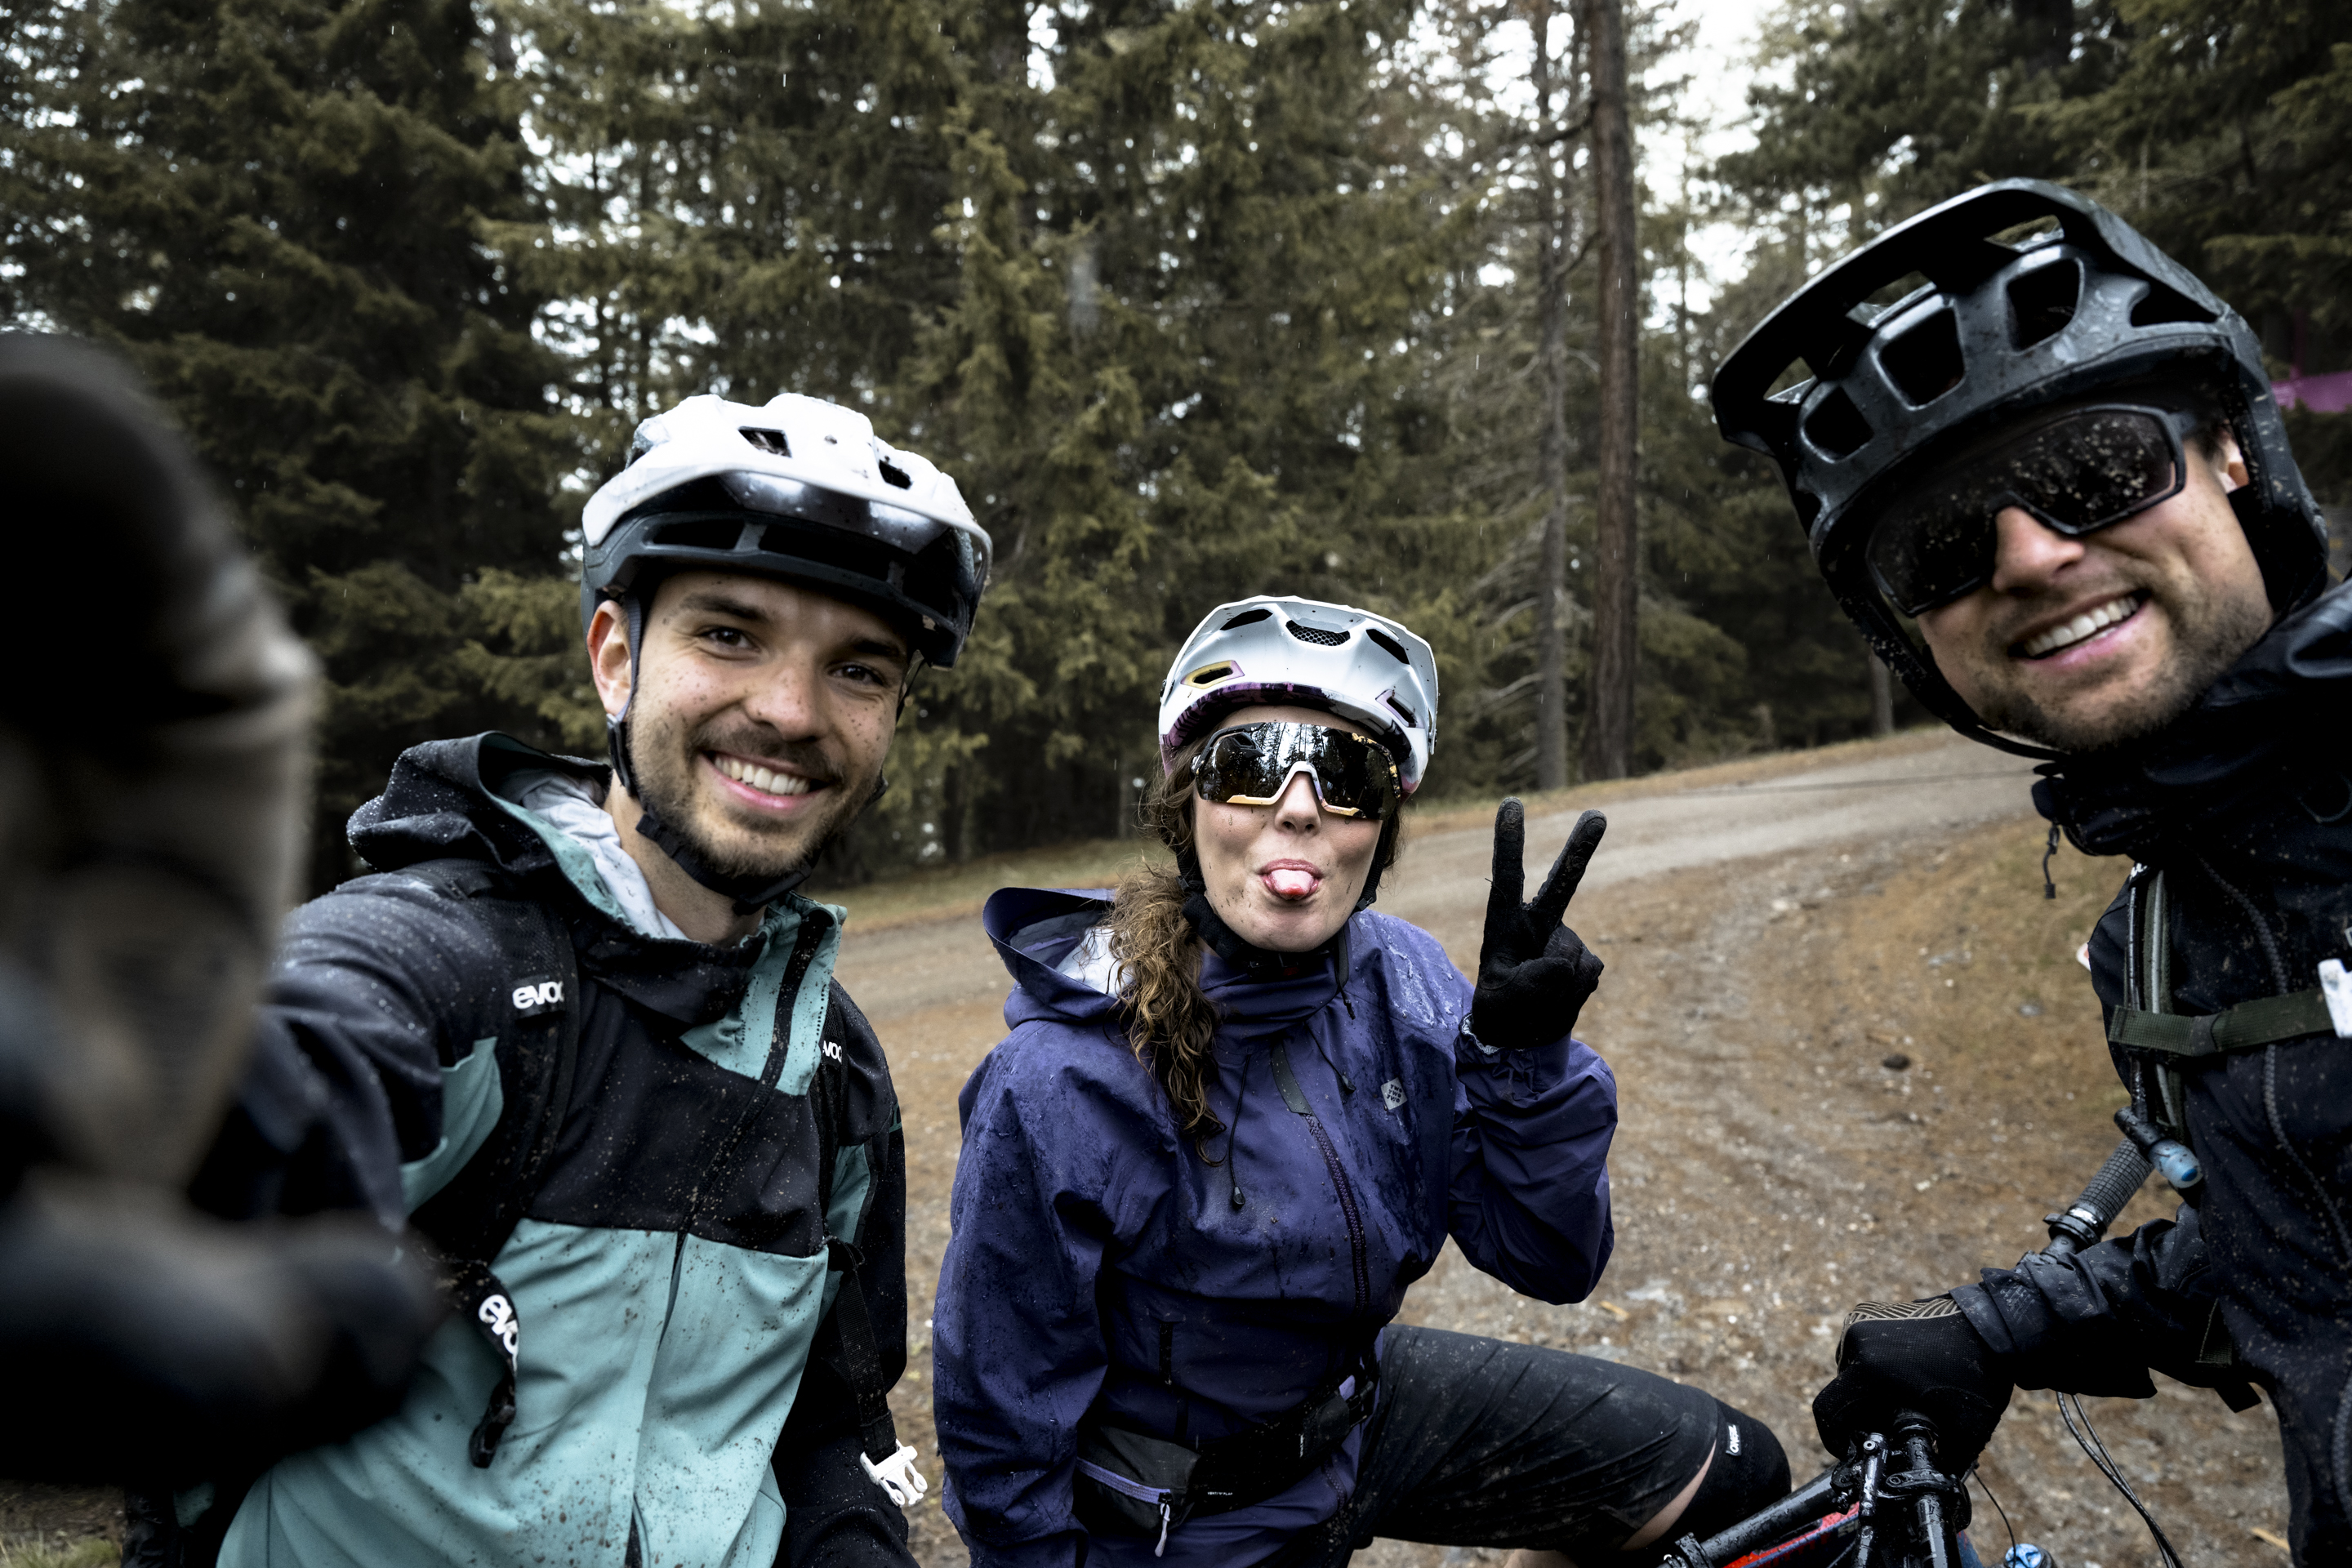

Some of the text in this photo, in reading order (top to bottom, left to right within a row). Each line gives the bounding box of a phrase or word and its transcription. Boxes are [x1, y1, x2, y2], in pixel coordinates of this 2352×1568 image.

[822, 1040, 842, 1064] voc
[1388, 1089, 1401, 1098] TWO
[1390, 1084, 1402, 1093] TWO
[478, 1294, 519, 1372] evo
